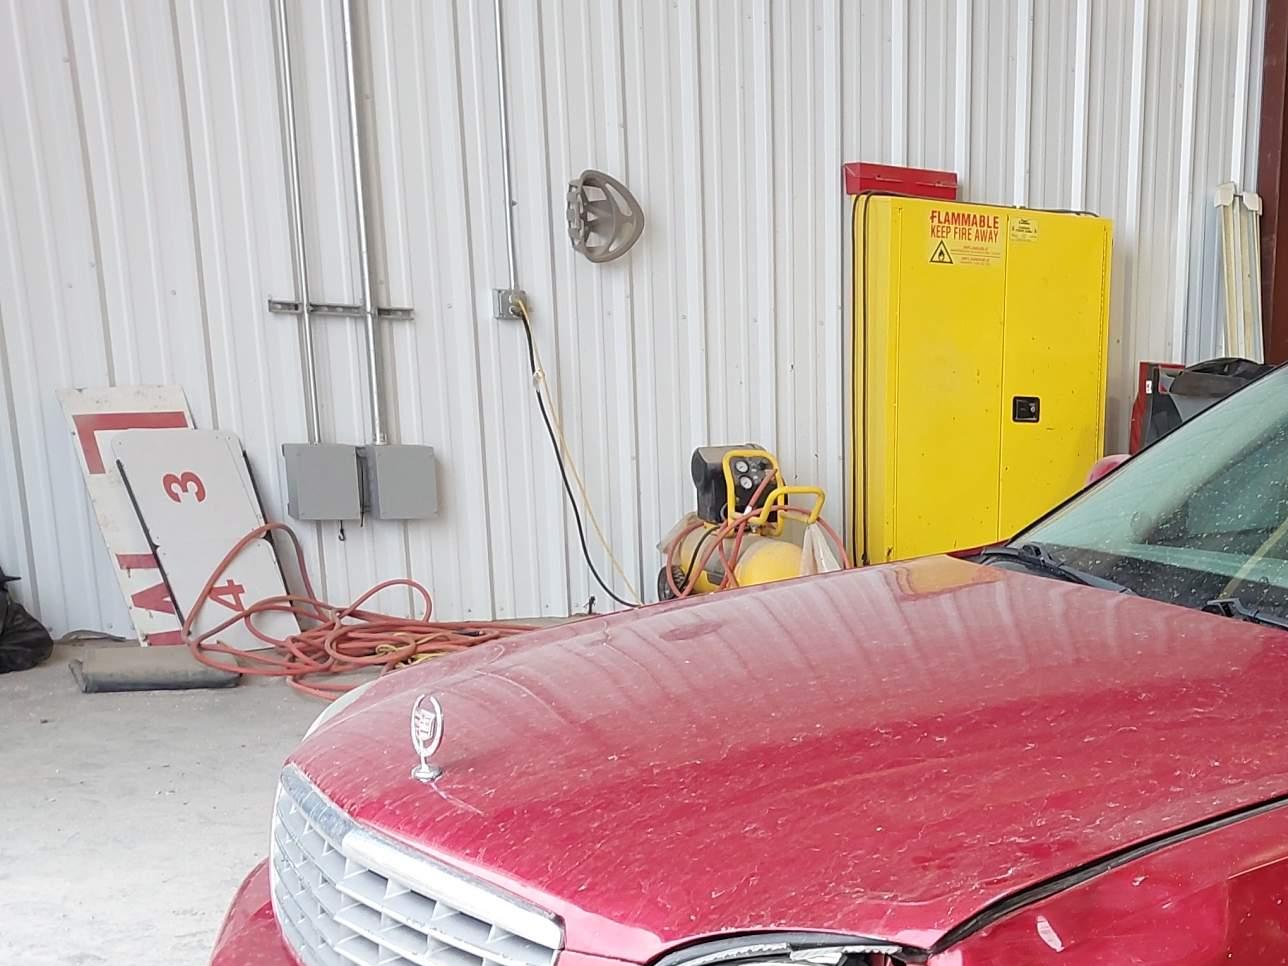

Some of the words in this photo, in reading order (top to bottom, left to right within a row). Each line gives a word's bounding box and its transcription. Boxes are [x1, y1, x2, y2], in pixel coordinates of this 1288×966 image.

[930, 210, 999, 229] FLAMMABLE
[930, 225, 951, 239] KEEP
[953, 227, 972, 241] FIRE
[974, 229, 999, 243] AWAY
[162, 471, 206, 503] 3
[206, 579, 246, 612] 4
